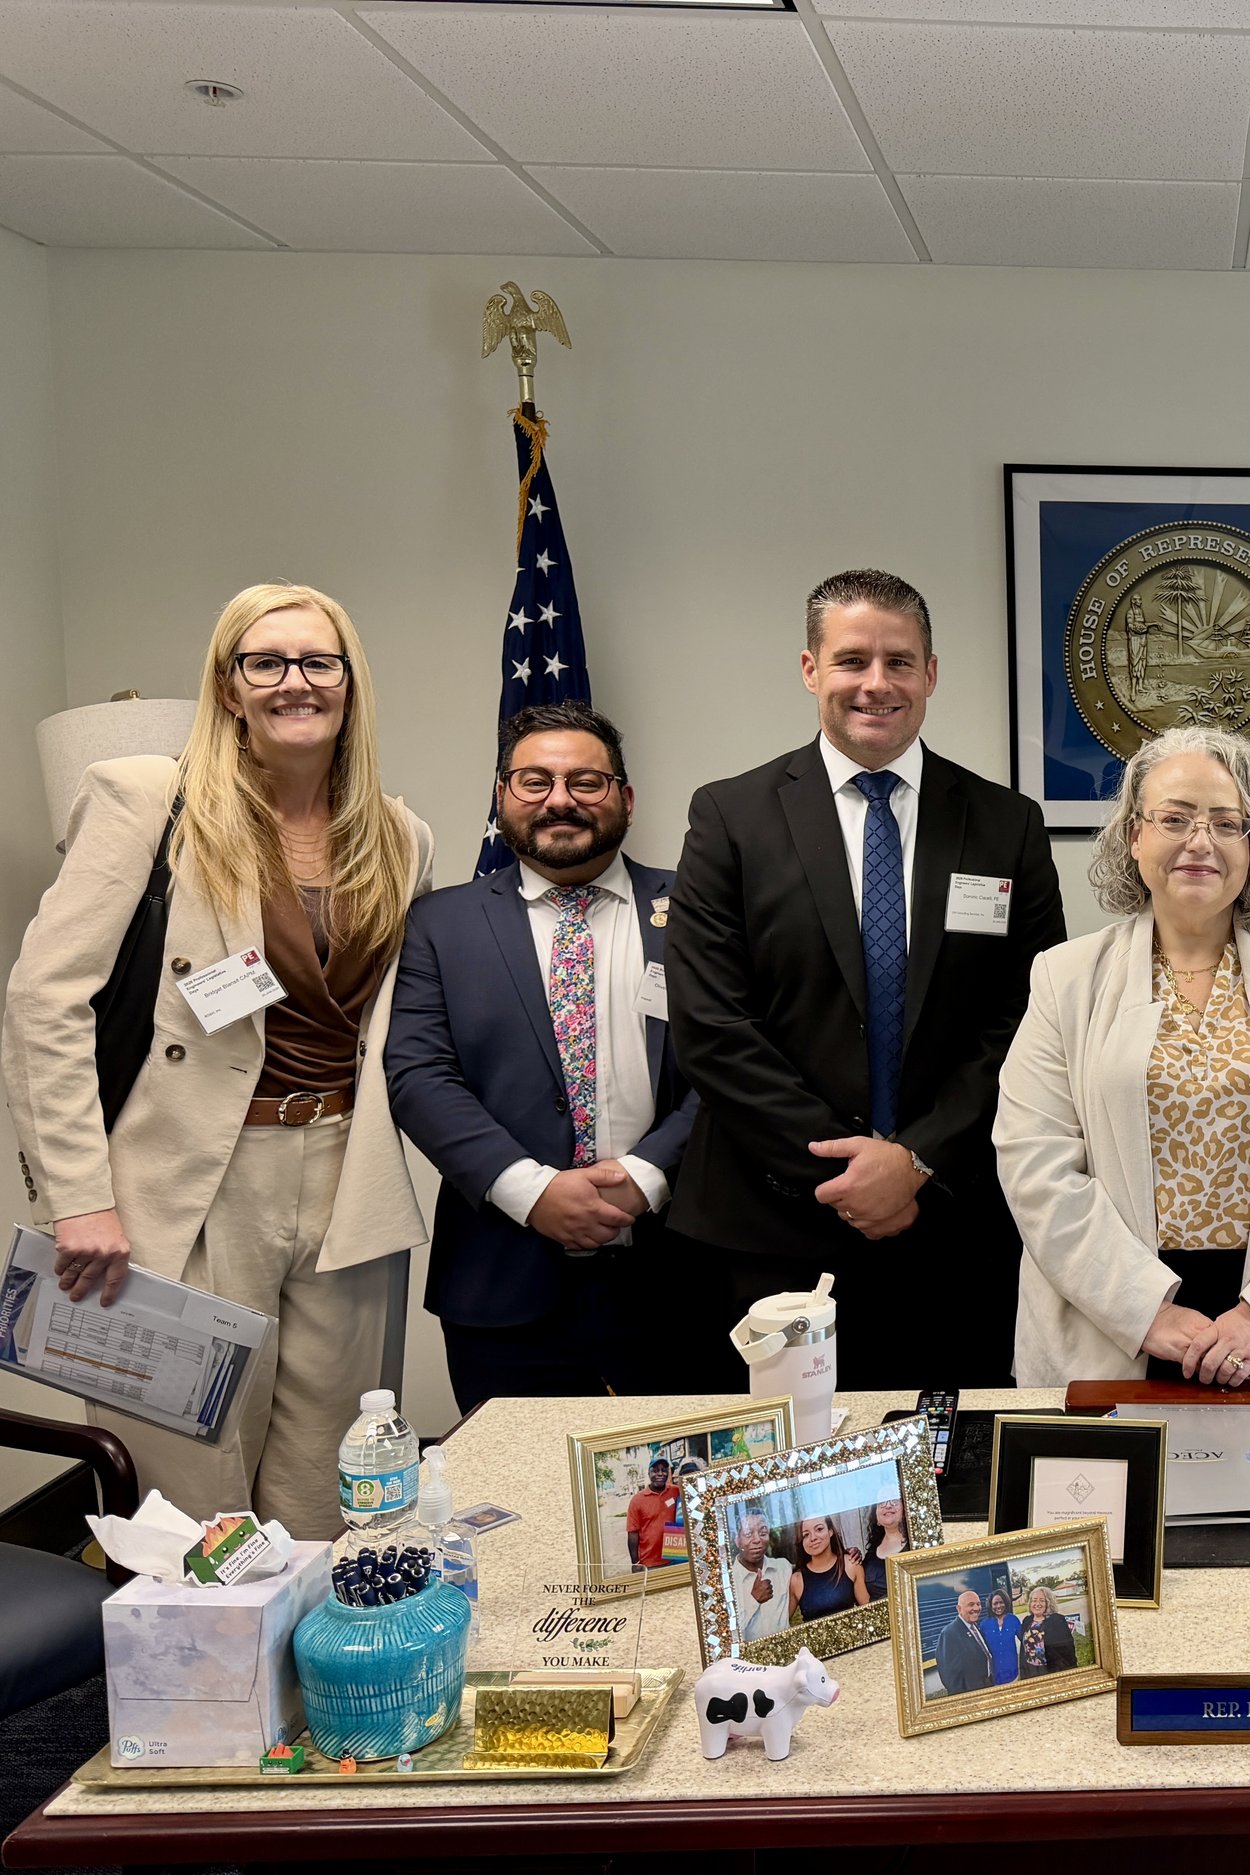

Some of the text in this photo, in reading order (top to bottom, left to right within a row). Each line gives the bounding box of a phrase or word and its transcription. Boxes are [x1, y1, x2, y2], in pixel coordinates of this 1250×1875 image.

[1078, 597, 1106, 682] HOUSE
[1106, 559, 1130, 587] OF
[241, 953, 255, 962] PE
[204, 986, 222, 998] Bridget
[213, 1315, 231, 1326] Team
[220, 1566, 229, 1575] It's
[240, 1549, 249, 1557] I'm
[248, 1539, 259, 1549] Fine
[225, 1541, 265, 1579] Everything's Fine
[543, 1584, 630, 1593] NEVER FORGET
[572, 1597, 596, 1606] THE
[532, 1608, 627, 1642] difference
[542, 1657, 610, 1667] YOU MAKE
[731, 1664, 767, 1673] fairlife
[1202, 1701, 1242, 1718] REP.
[122, 1739, 141, 1754] Puffs
